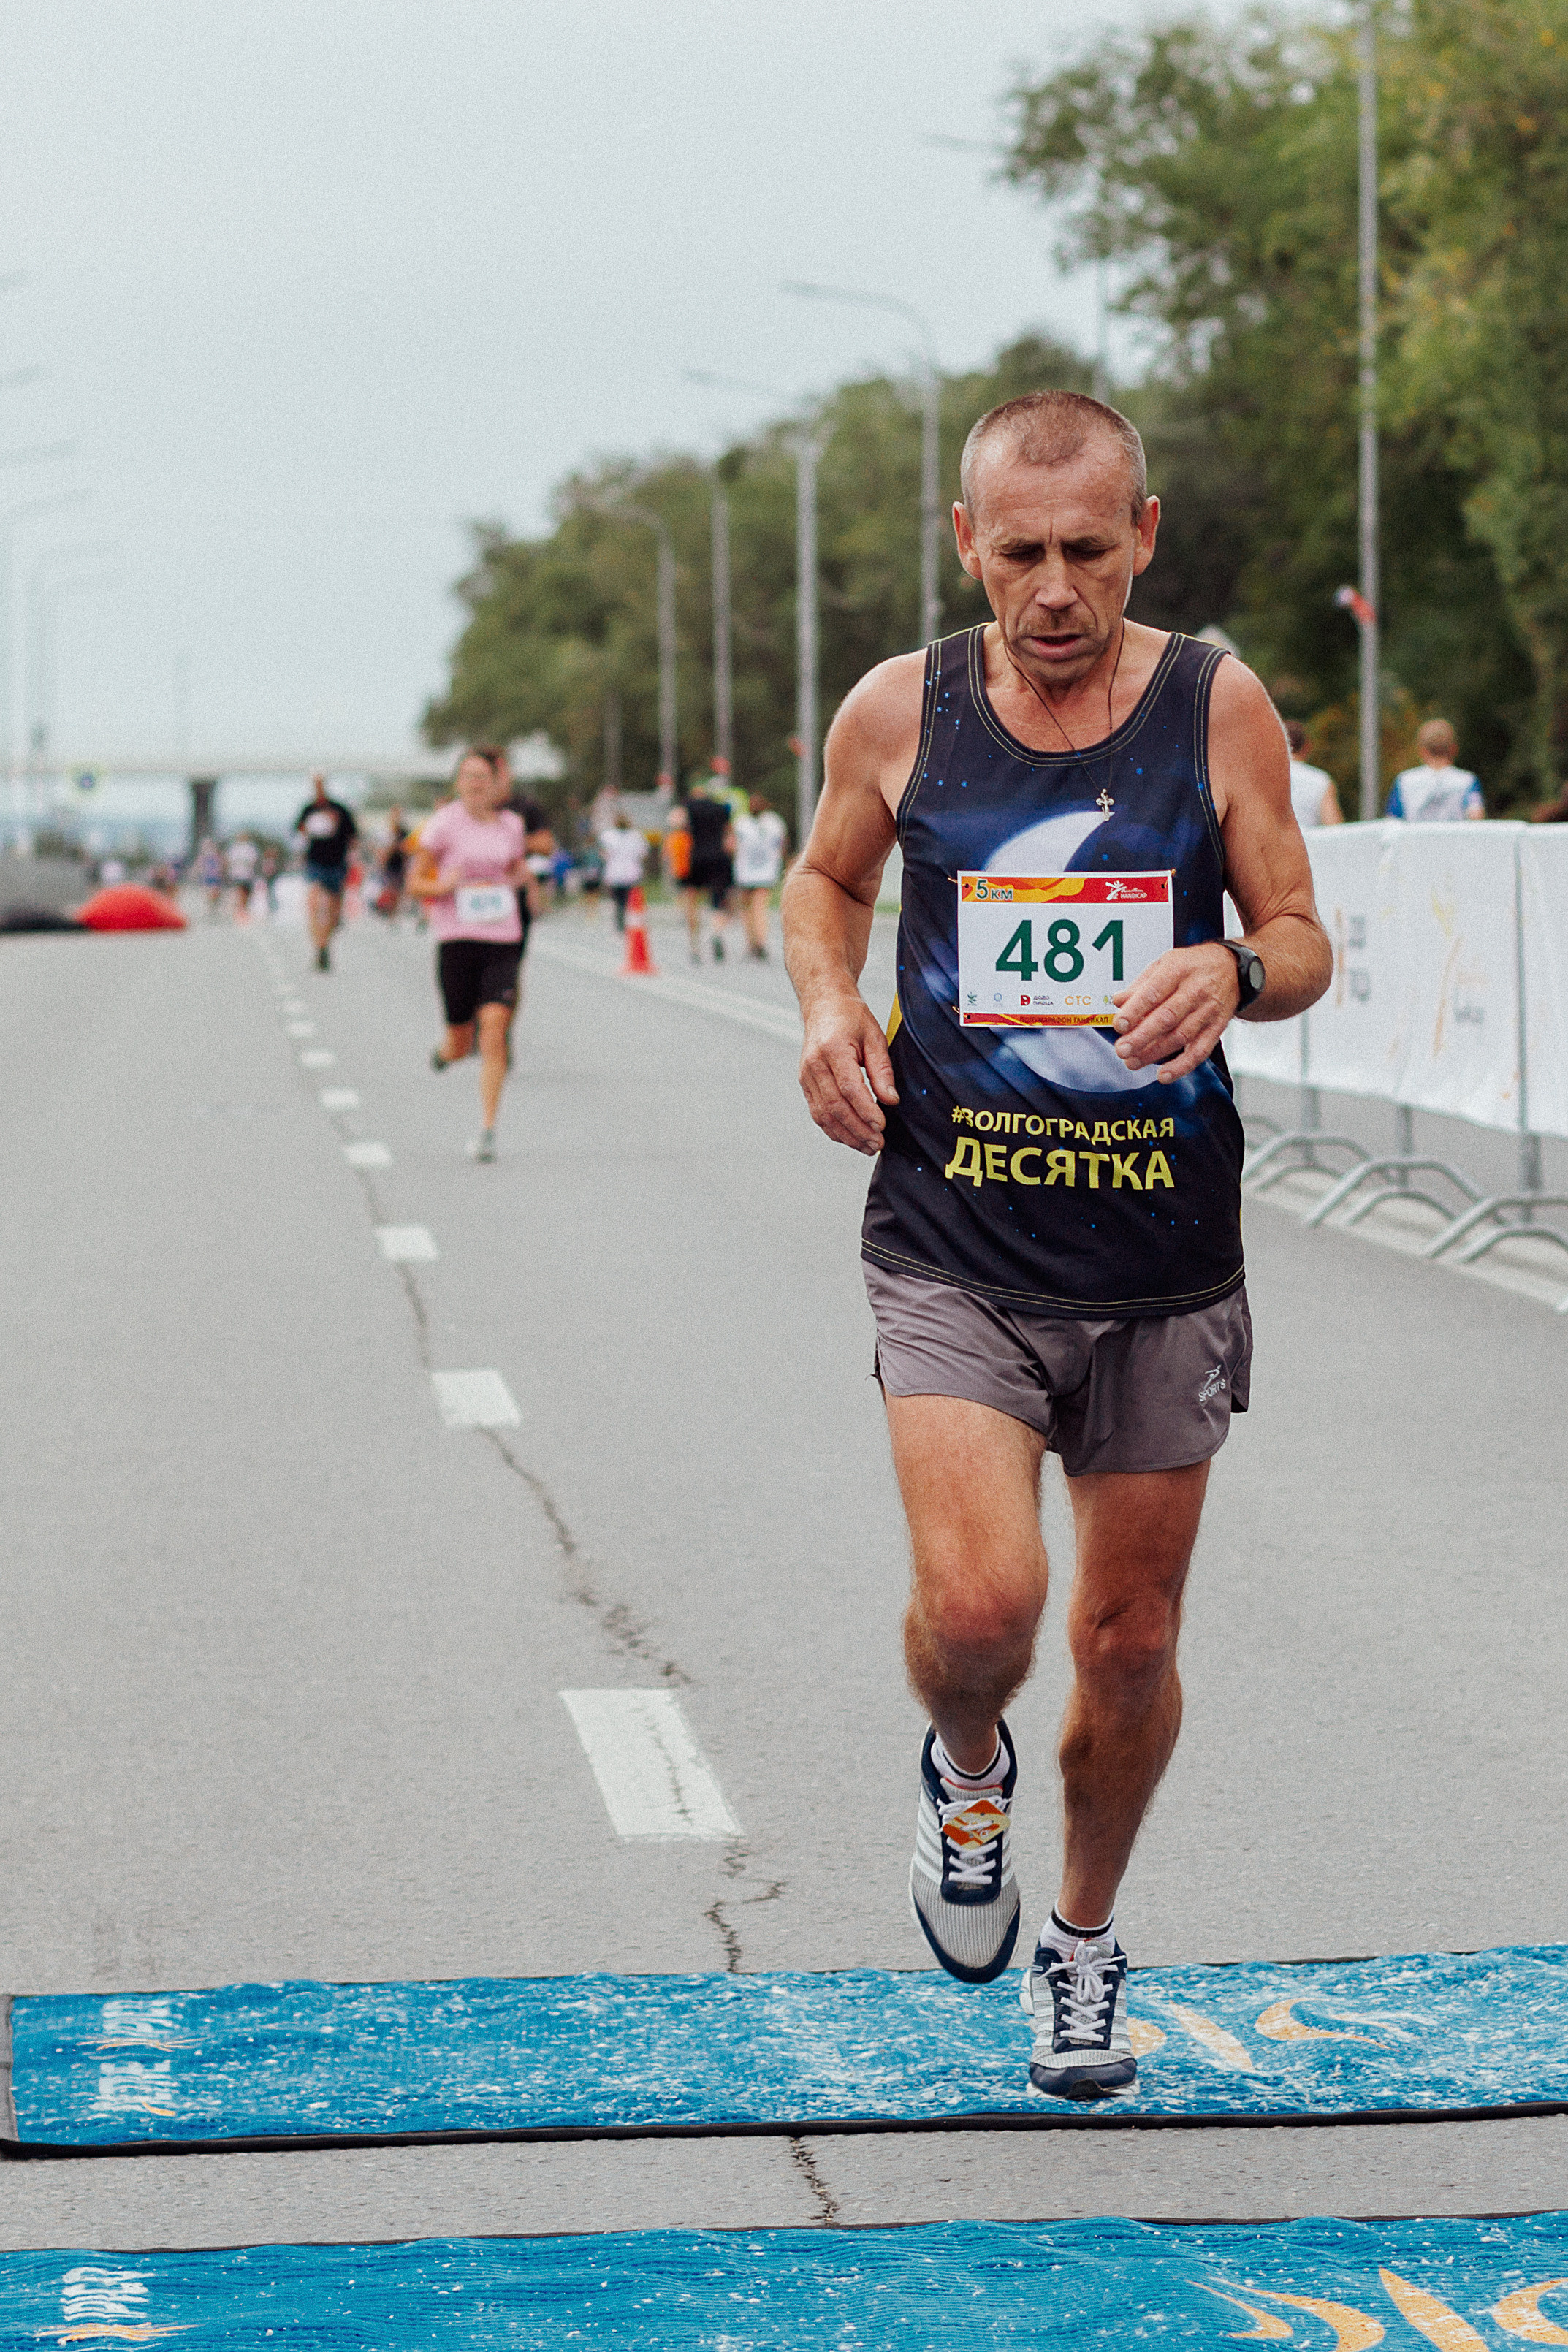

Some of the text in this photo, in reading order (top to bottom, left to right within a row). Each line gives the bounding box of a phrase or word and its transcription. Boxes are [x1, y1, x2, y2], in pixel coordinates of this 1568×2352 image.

[975, 879, 989, 899] 5
[995, 918, 1124, 983] 481
[1065, 996, 1092, 1005] СТС
[951, 1105, 1174, 1146] #ВОЛГОГРАДСКАЯ
[945, 1136, 1175, 1190] ДЕСЯТКА
